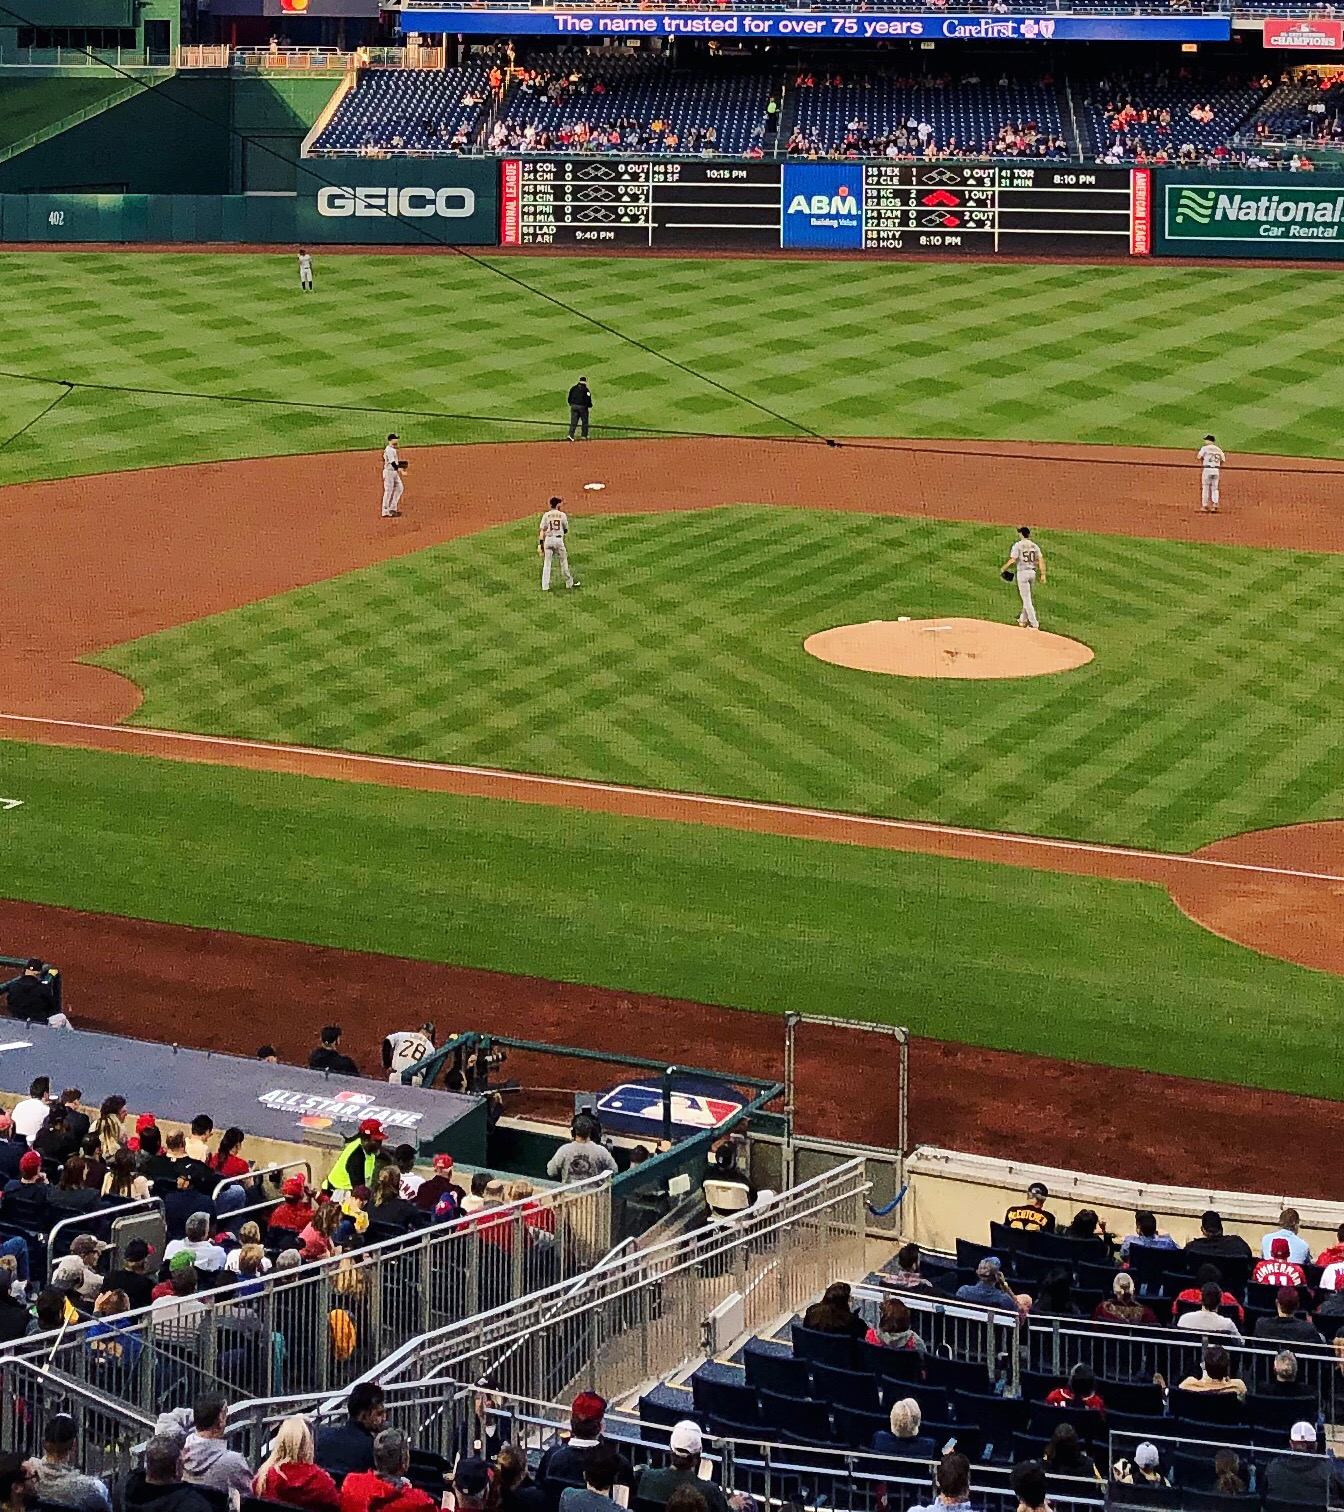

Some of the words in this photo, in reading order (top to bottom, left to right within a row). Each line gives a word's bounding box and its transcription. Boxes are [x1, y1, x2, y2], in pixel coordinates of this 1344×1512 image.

[554, 15, 592, 33] The
[598, 18, 657, 33] name
[663, 16, 738, 34] trusted
[743, 16, 774, 34] for
[778, 20, 825, 34] over
[831, 18, 858, 34] 75
[864, 19, 923, 37] years
[942, 20, 1018, 39] CareFirst
[1270, 37, 1336, 47] CHAMPIONS
[706, 169, 729, 179] 10:15
[731, 170, 747, 179] PM
[1054, 174, 1076, 184] 8:10
[1078, 175, 1095, 185] PM
[317, 186, 475, 218] GEICO
[787, 194, 857, 215] ABM
[576, 230, 597, 240] 9:40
[599, 230, 614, 240] PM
[1259, 225, 1286, 237] Car
[1289, 225, 1338, 238] Rental
[920, 235, 942, 245] 8:10
[945, 236, 961, 246] PM
[549, 519, 561, 531] 19
[1022, 550, 1036, 563] 50
[399, 1039, 427, 1061] 28
[258, 1089, 302, 1105] ALL
[300, 1096, 360, 1116] STAR
[358, 1107, 423, 1127] GAME
